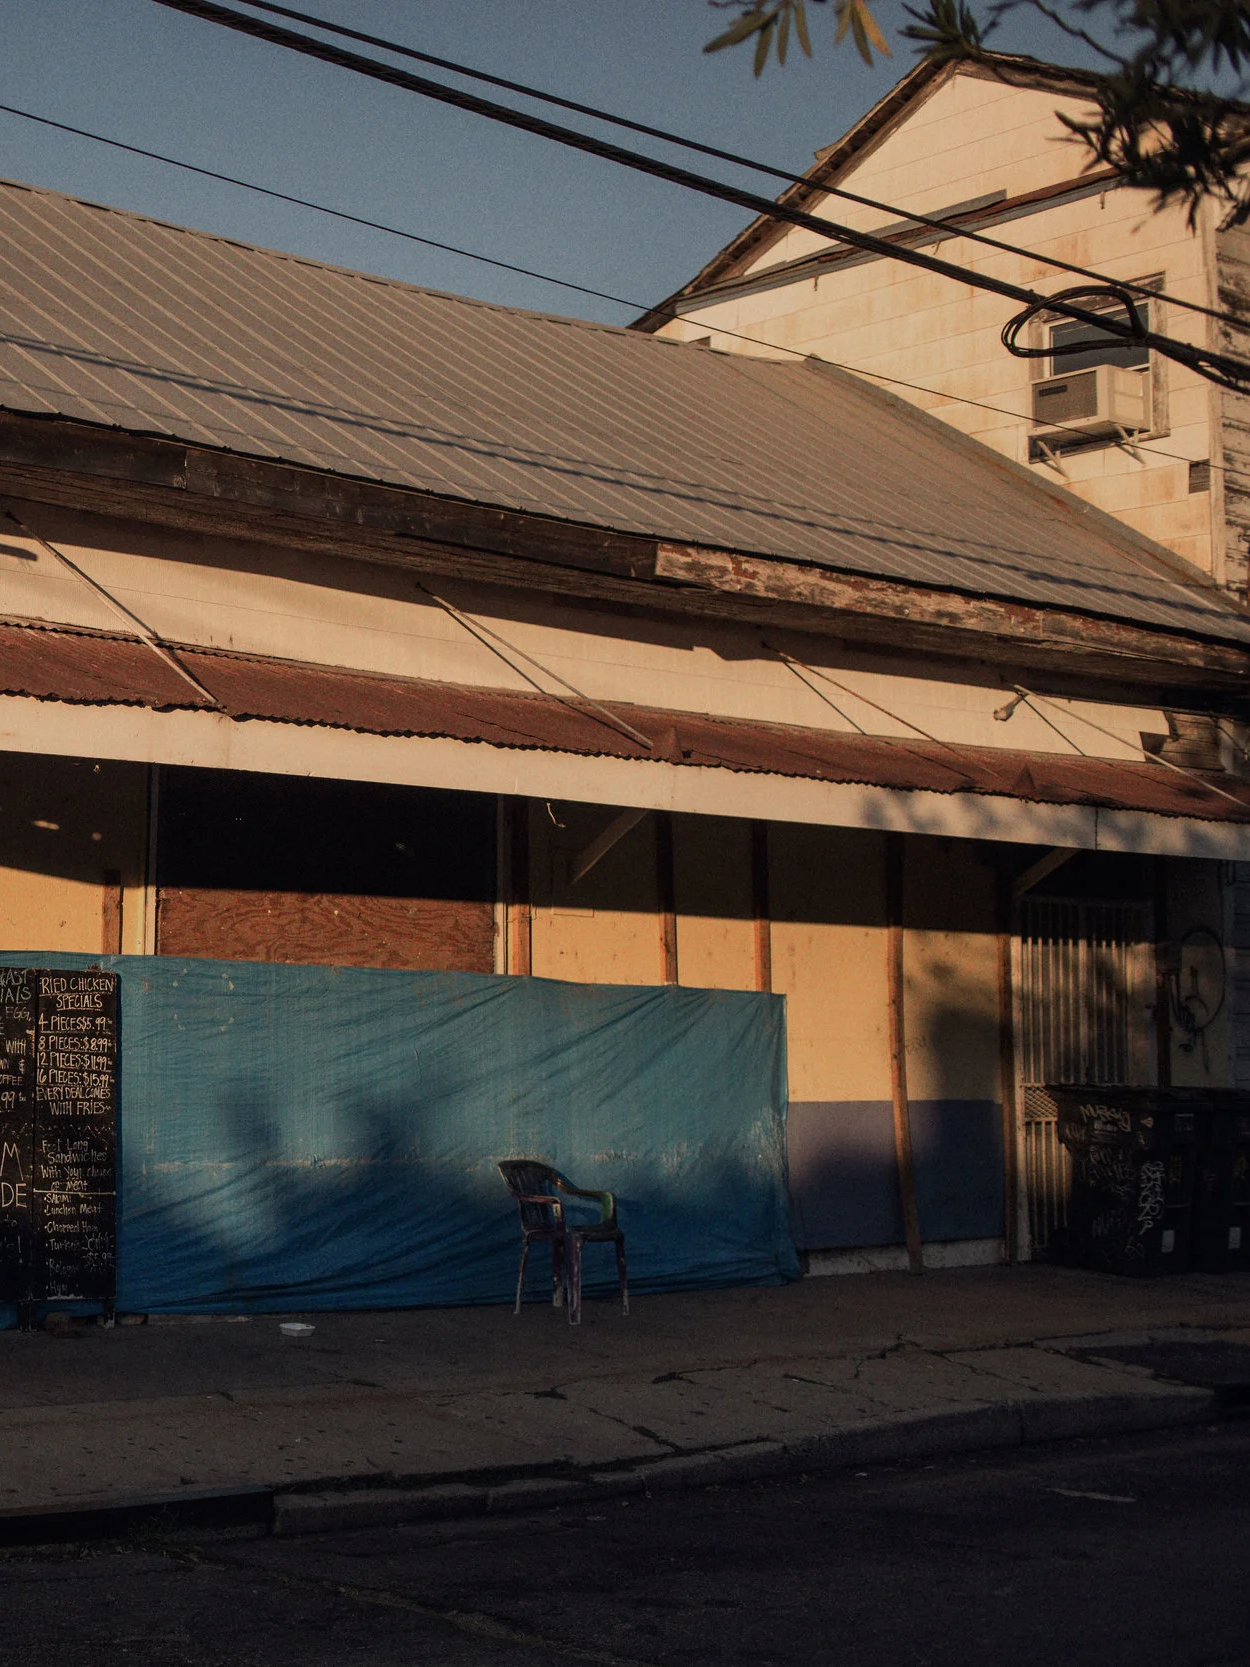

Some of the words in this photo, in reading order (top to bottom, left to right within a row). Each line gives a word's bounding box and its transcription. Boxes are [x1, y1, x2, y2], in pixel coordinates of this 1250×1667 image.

[70, 977, 114, 992] CHICKEN
[56, 993, 104, 1010] SPECIALS
[38, 1012, 49, 1031] 4
[5, 1037, 27, 1056] WITH
[38, 1035, 46, 1050] 8
[36, 1051, 49, 1067] 12
[36, 1068, 48, 1083] 16
[36, 1086, 64, 1101] EVERY
[64, 1086, 85, 1099] DEAL
[49, 1101, 72, 1116] WITH
